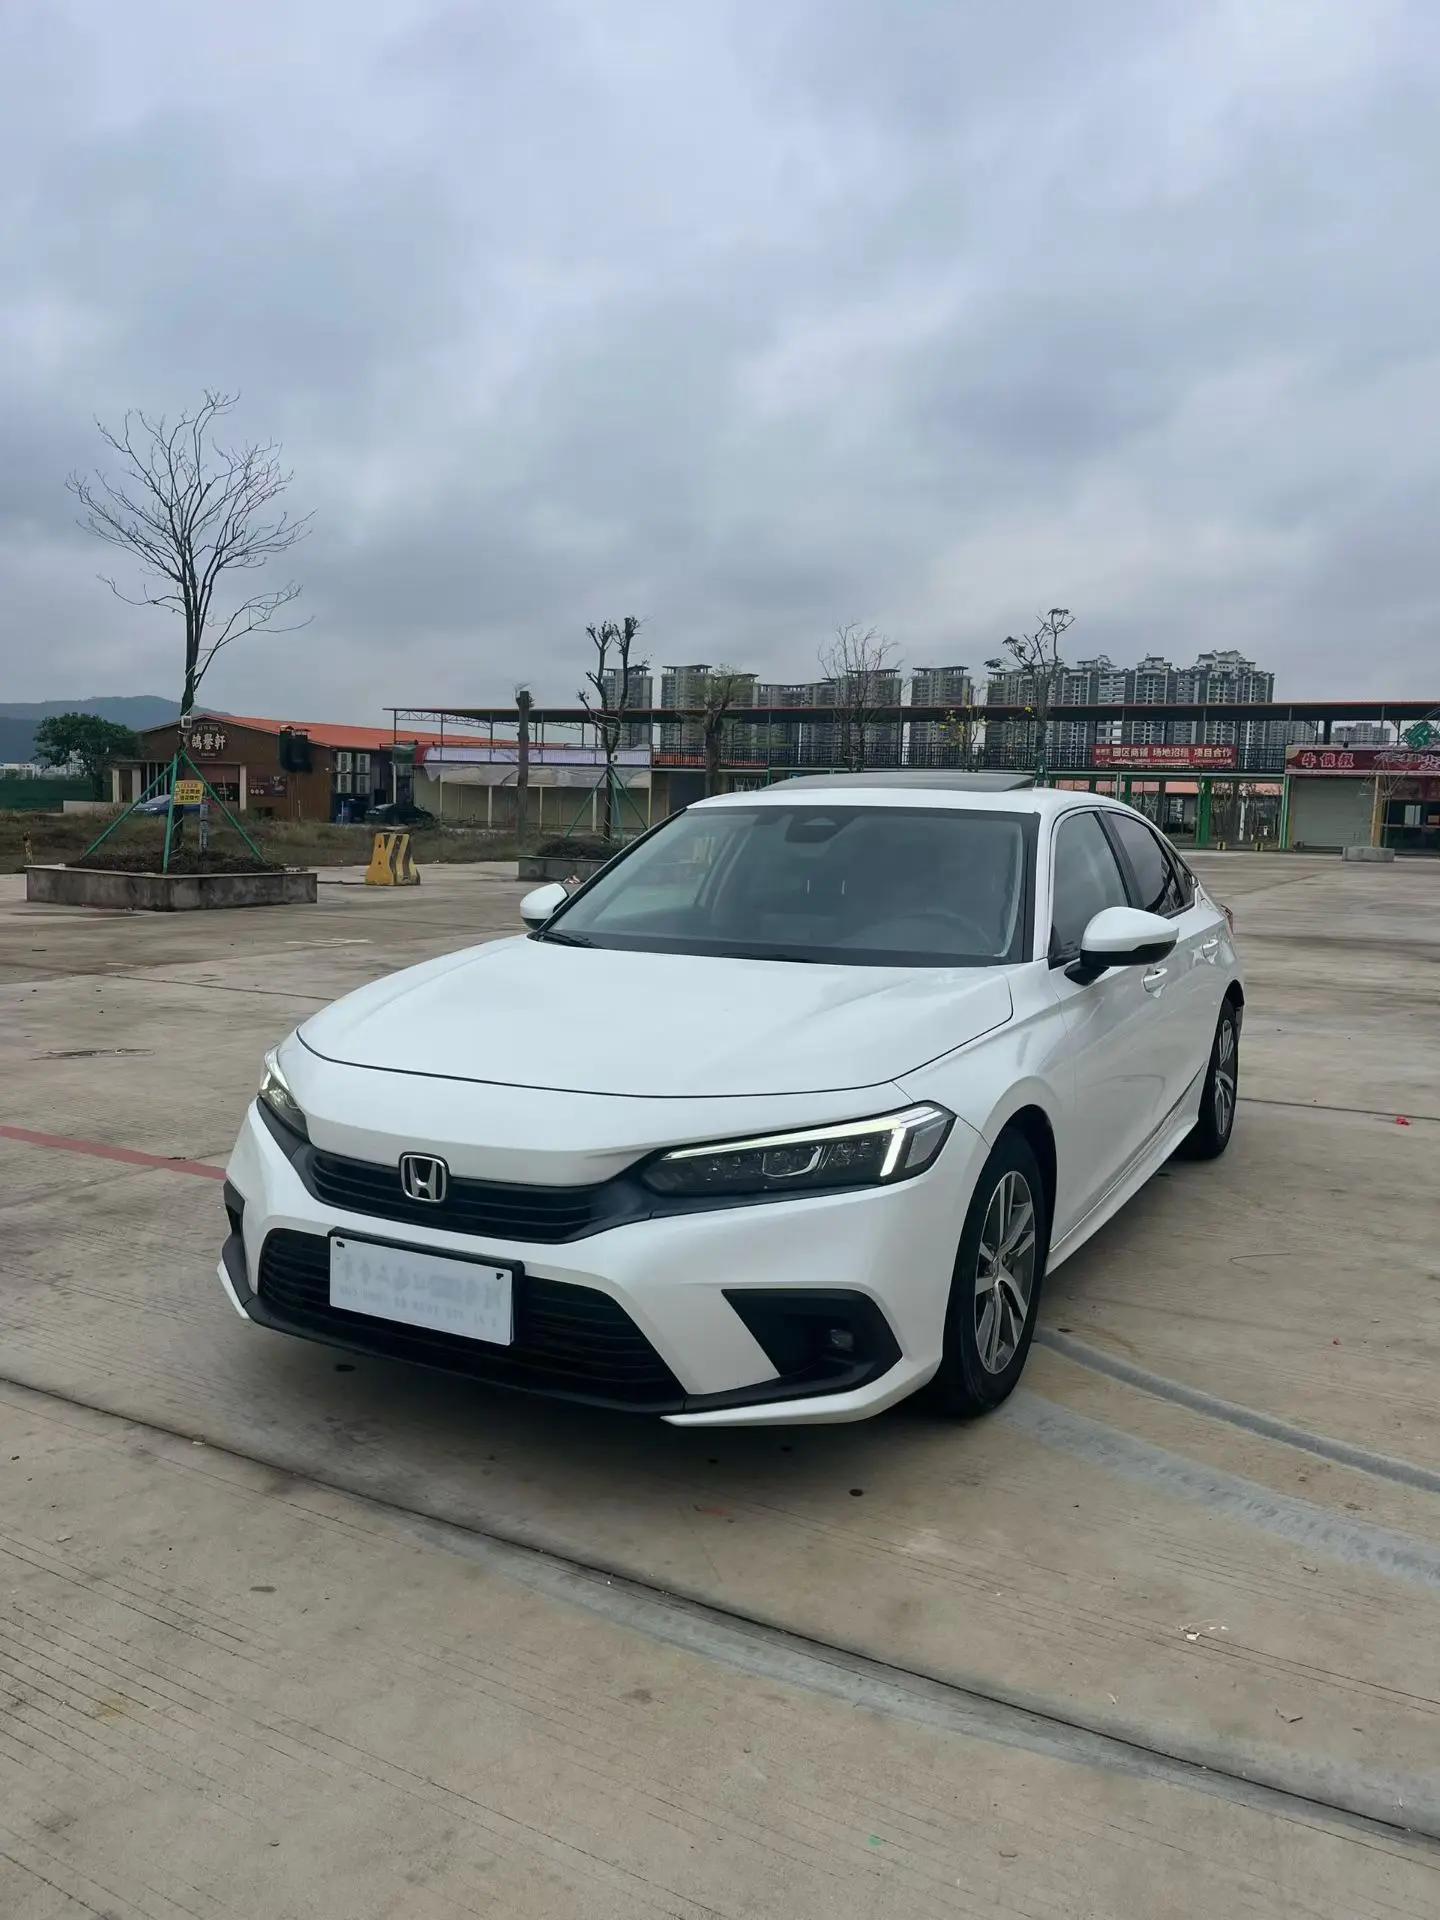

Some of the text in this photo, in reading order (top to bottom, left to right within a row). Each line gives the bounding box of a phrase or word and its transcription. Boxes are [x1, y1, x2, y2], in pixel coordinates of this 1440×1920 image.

[1152, 747, 1189, 757] 场地招租
[1194, 747, 1233, 757] 项目合作
